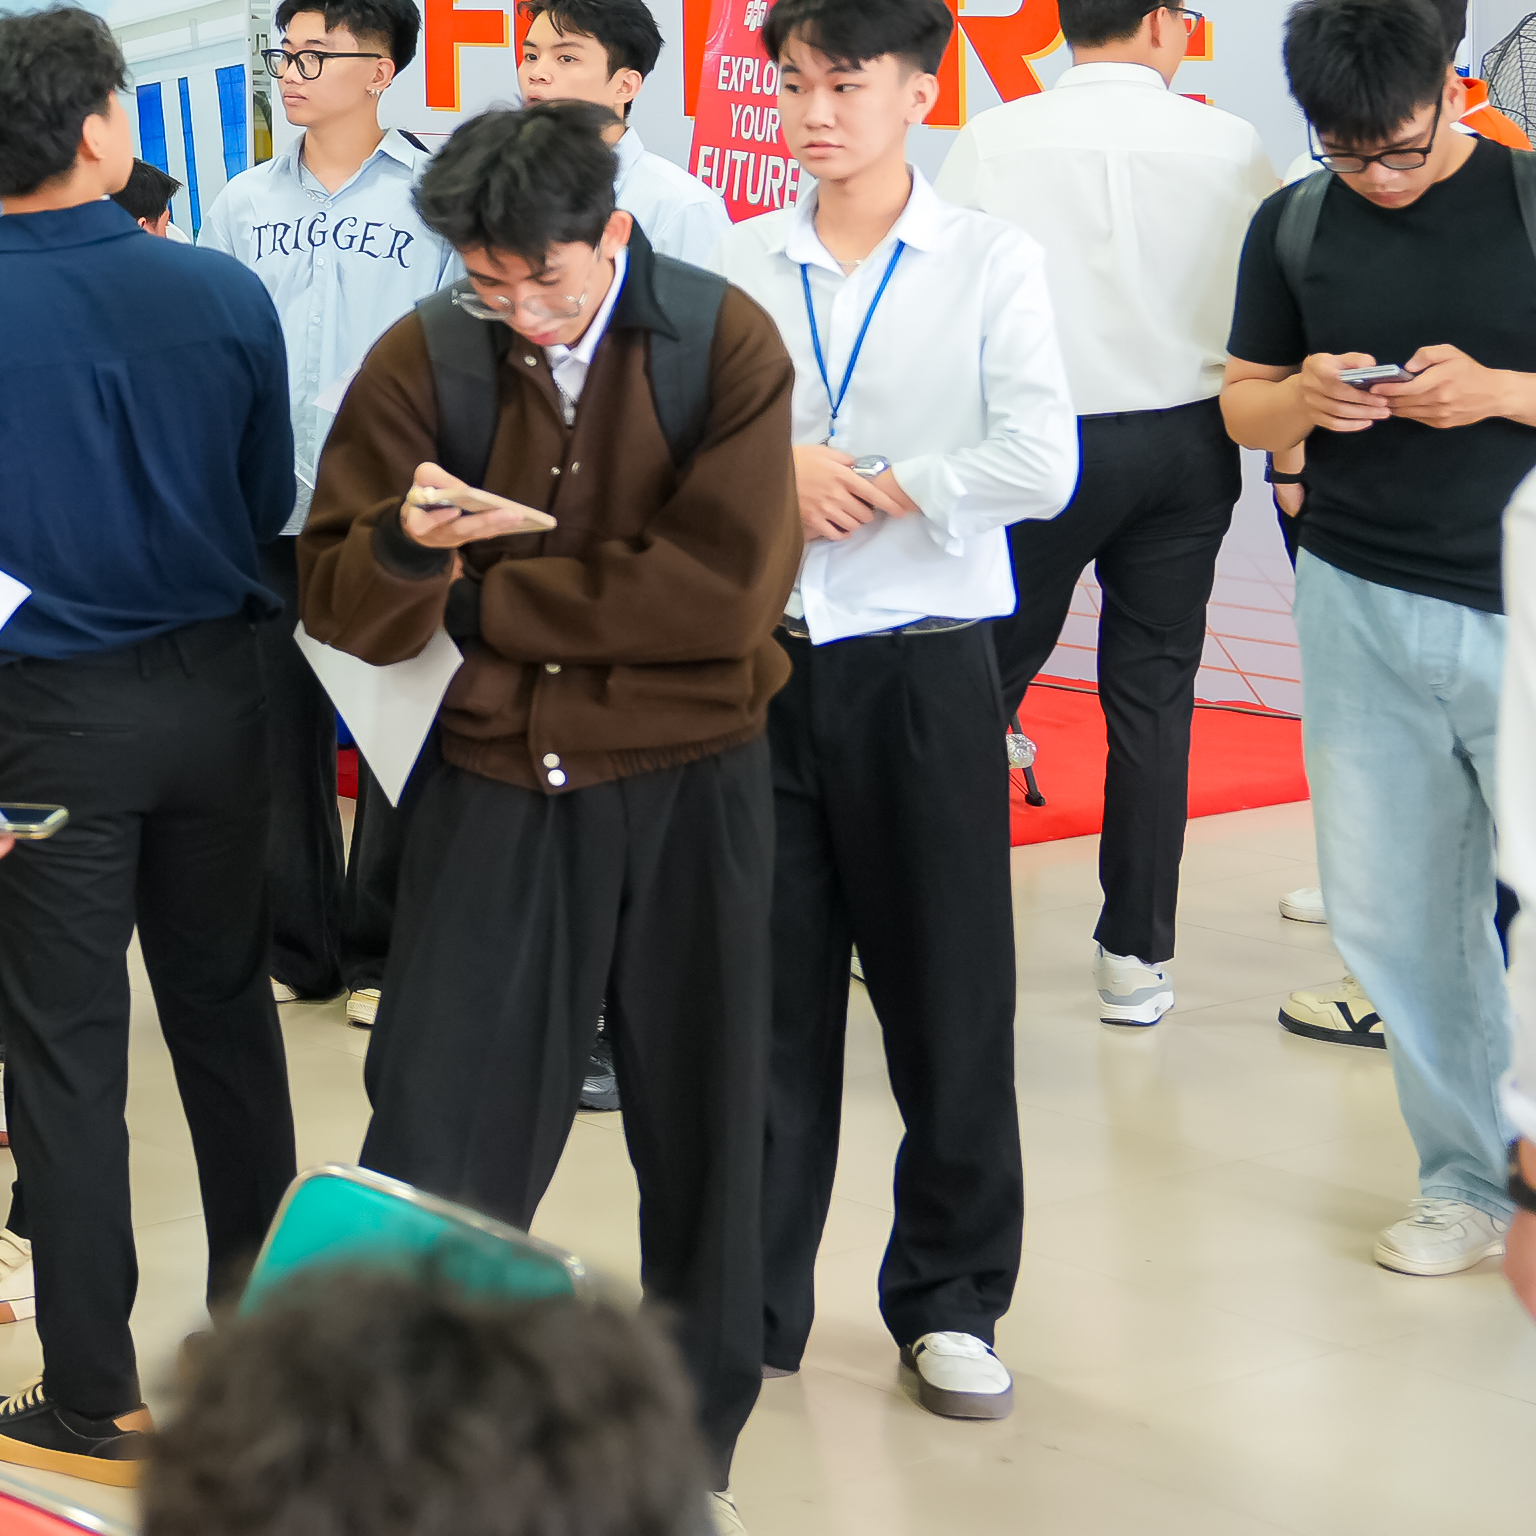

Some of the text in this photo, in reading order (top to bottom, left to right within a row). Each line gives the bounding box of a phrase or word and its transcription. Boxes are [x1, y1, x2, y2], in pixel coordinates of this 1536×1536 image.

[717, 55, 778, 96] EXPLO
[730, 103, 780, 143] YOUR
[697, 145, 801, 208] FUTURE
[252, 211, 415, 269] TRIGGER
